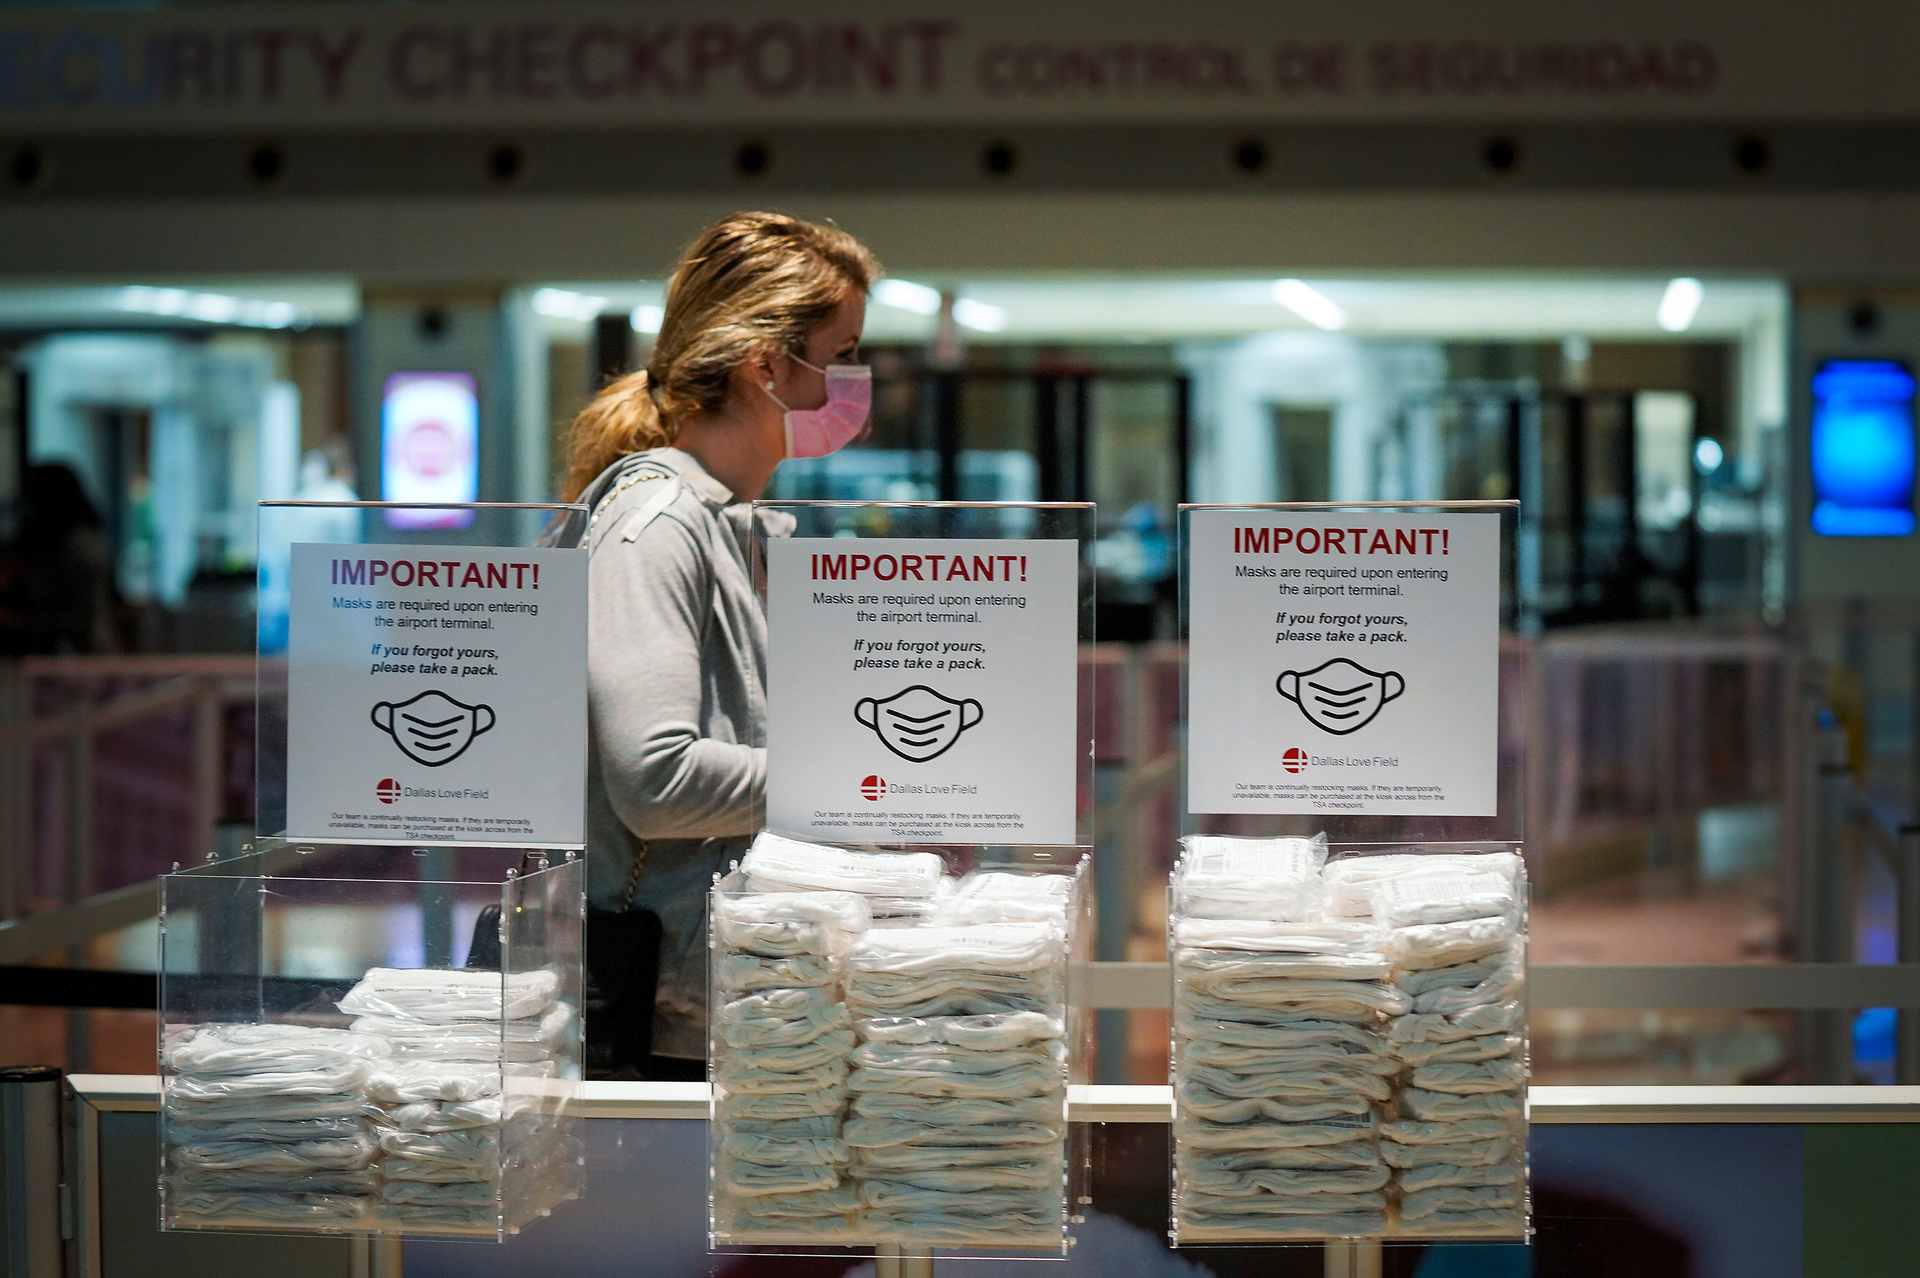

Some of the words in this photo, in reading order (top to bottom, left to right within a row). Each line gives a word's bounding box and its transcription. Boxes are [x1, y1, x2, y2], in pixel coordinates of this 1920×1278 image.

[386, 18, 957, 103] CHECKPOINT
[975, 39, 1257, 97] CONTROL
[1274, 39, 1346, 97] DE
[1369, 39, 1719, 97] SEGURIDAD
[1234, 527, 1449, 555] IMPORTANT!
[332, 559, 539, 590] IMPORTANT!
[811, 553, 1027, 582] IMPORTANT!
[1235, 565, 1277, 577] Masks
[1280, 568, 1301, 578] are
[1305, 566, 1357, 581] required
[1361, 569, 1393, 581] upon
[1396, 567, 1448, 582] entering
[1279, 584, 1300, 595] the
[1303, 584, 1345, 598] airport
[1348, 584, 1403, 596] terminal.
[333, 597, 372, 609] Masks
[376, 600, 396, 610] are
[399, 598, 450, 614] required
[454, 602, 484, 615] upon
[488, 600, 538, 616] entering
[813, 592, 854, 604] Masks
[858, 595, 879, 605] are
[882, 593, 935, 608] required
[939, 596, 971, 608] upon
[975, 593, 1026, 608] entering
[374, 615, 394, 627] the
[397, 615, 438, 630] airport
[441, 617, 495, 630] terminal.
[856, 610, 876, 622] the
[881, 610, 922, 624] airport
[926, 611, 981, 623] terminal.
[1276, 612, 1287, 623] If
[1288, 615, 1315, 626] you
[1319, 612, 1362, 627] forgot
[1364, 616, 1408, 627] yours,
[1275, 630, 1322, 644] please
[1326, 631, 1355, 642] take
[1358, 633, 1367, 642] a
[1370, 631, 1407, 645] pack.
[371, 643, 382, 655] If
[383, 647, 409, 659] you
[412, 645, 454, 660] forgot
[456, 648, 498, 661] yours,
[854, 639, 864, 650] If
[867, 642, 892, 653] you
[897, 639, 939, 653] forgot
[943, 643, 985, 654] yours,
[370, 661, 415, 676] please
[419, 662, 447, 674] take
[450, 666, 459, 674] a
[462, 663, 498, 678] pack.
[853, 657, 900, 671] please
[904, 657, 933, 669] take
[936, 660, 945, 669] a
[948, 658, 985, 672] pack.
[1311, 756, 1344, 766] Dallas
[1346, 757, 1371, 767] Love
[1373, 757, 1398, 767] Field
[404, 787, 437, 798] Dallas
[438, 788, 462, 799] Love
[464, 788, 489, 799] Field
[890, 783, 923, 794] Dallas
[925, 784, 950, 794] Love
[952, 784, 977, 794] Field
[1275, 784, 1309, 792] continually
[1377, 785, 1391, 793] they
[1320, 793, 1354, 801] purchased
[370, 814, 402, 822] continually
[405, 816, 436, 824] restocking
[468, 817, 481, 825] they
[854, 811, 888, 819] continually
[890, 812, 924, 820] restocking
[413, 824, 445, 832] purchased
[467, 824, 482, 832] kiosk
